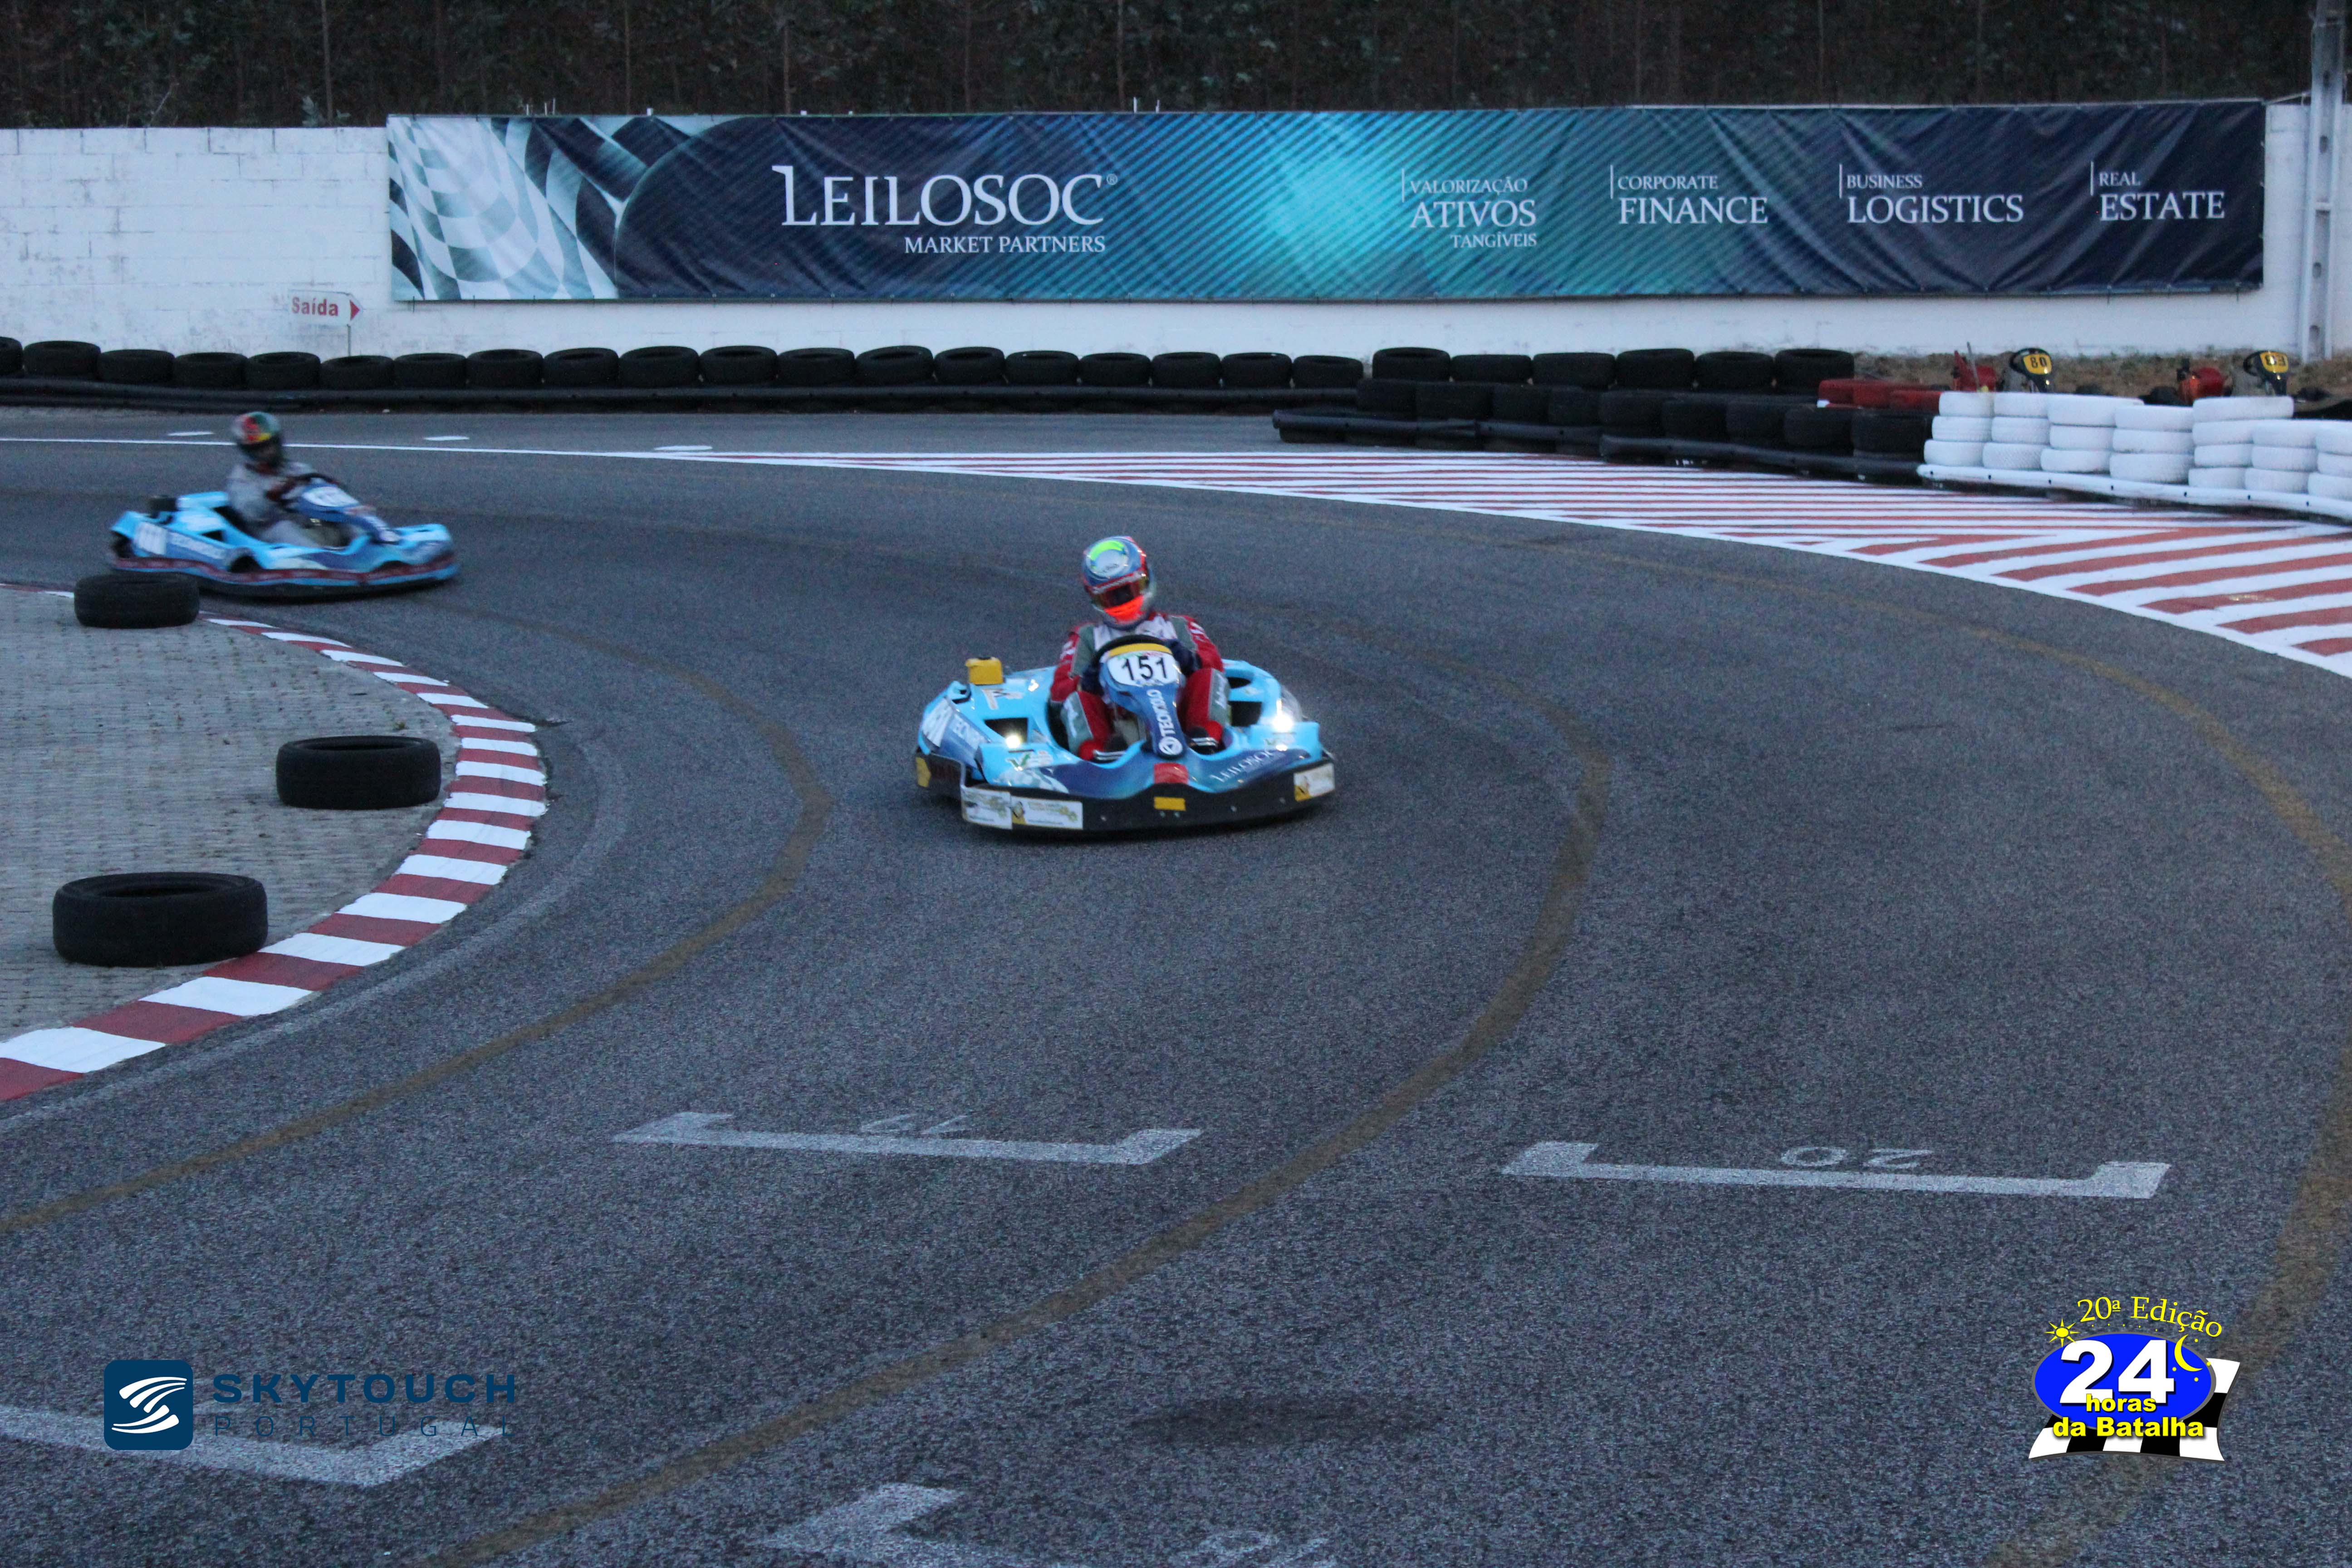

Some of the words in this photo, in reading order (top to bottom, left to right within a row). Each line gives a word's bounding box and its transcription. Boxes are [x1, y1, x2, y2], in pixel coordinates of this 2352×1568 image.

[1410, 176, 1528, 196] VALORIZAÇÃO
[1617, 175, 1719, 191] CORPORATE
[1846, 174, 1923, 189] BUSINESS
[2099, 172, 2141, 187] REAL
[1410, 199, 1537, 228] ATIVOS
[1618, 196, 1769, 225] FINANCE
[1847, 194, 2024, 224] LOGISTICS
[2100, 191, 2225, 221] ESTATE
[904, 236, 993, 254] MARKET
[999, 235, 1106, 253] PARTNERS
[1450, 230, 1537, 249] TANGÍVEIS
[292, 296, 338, 316] Saída
[1122, 655, 1167, 681] 151
